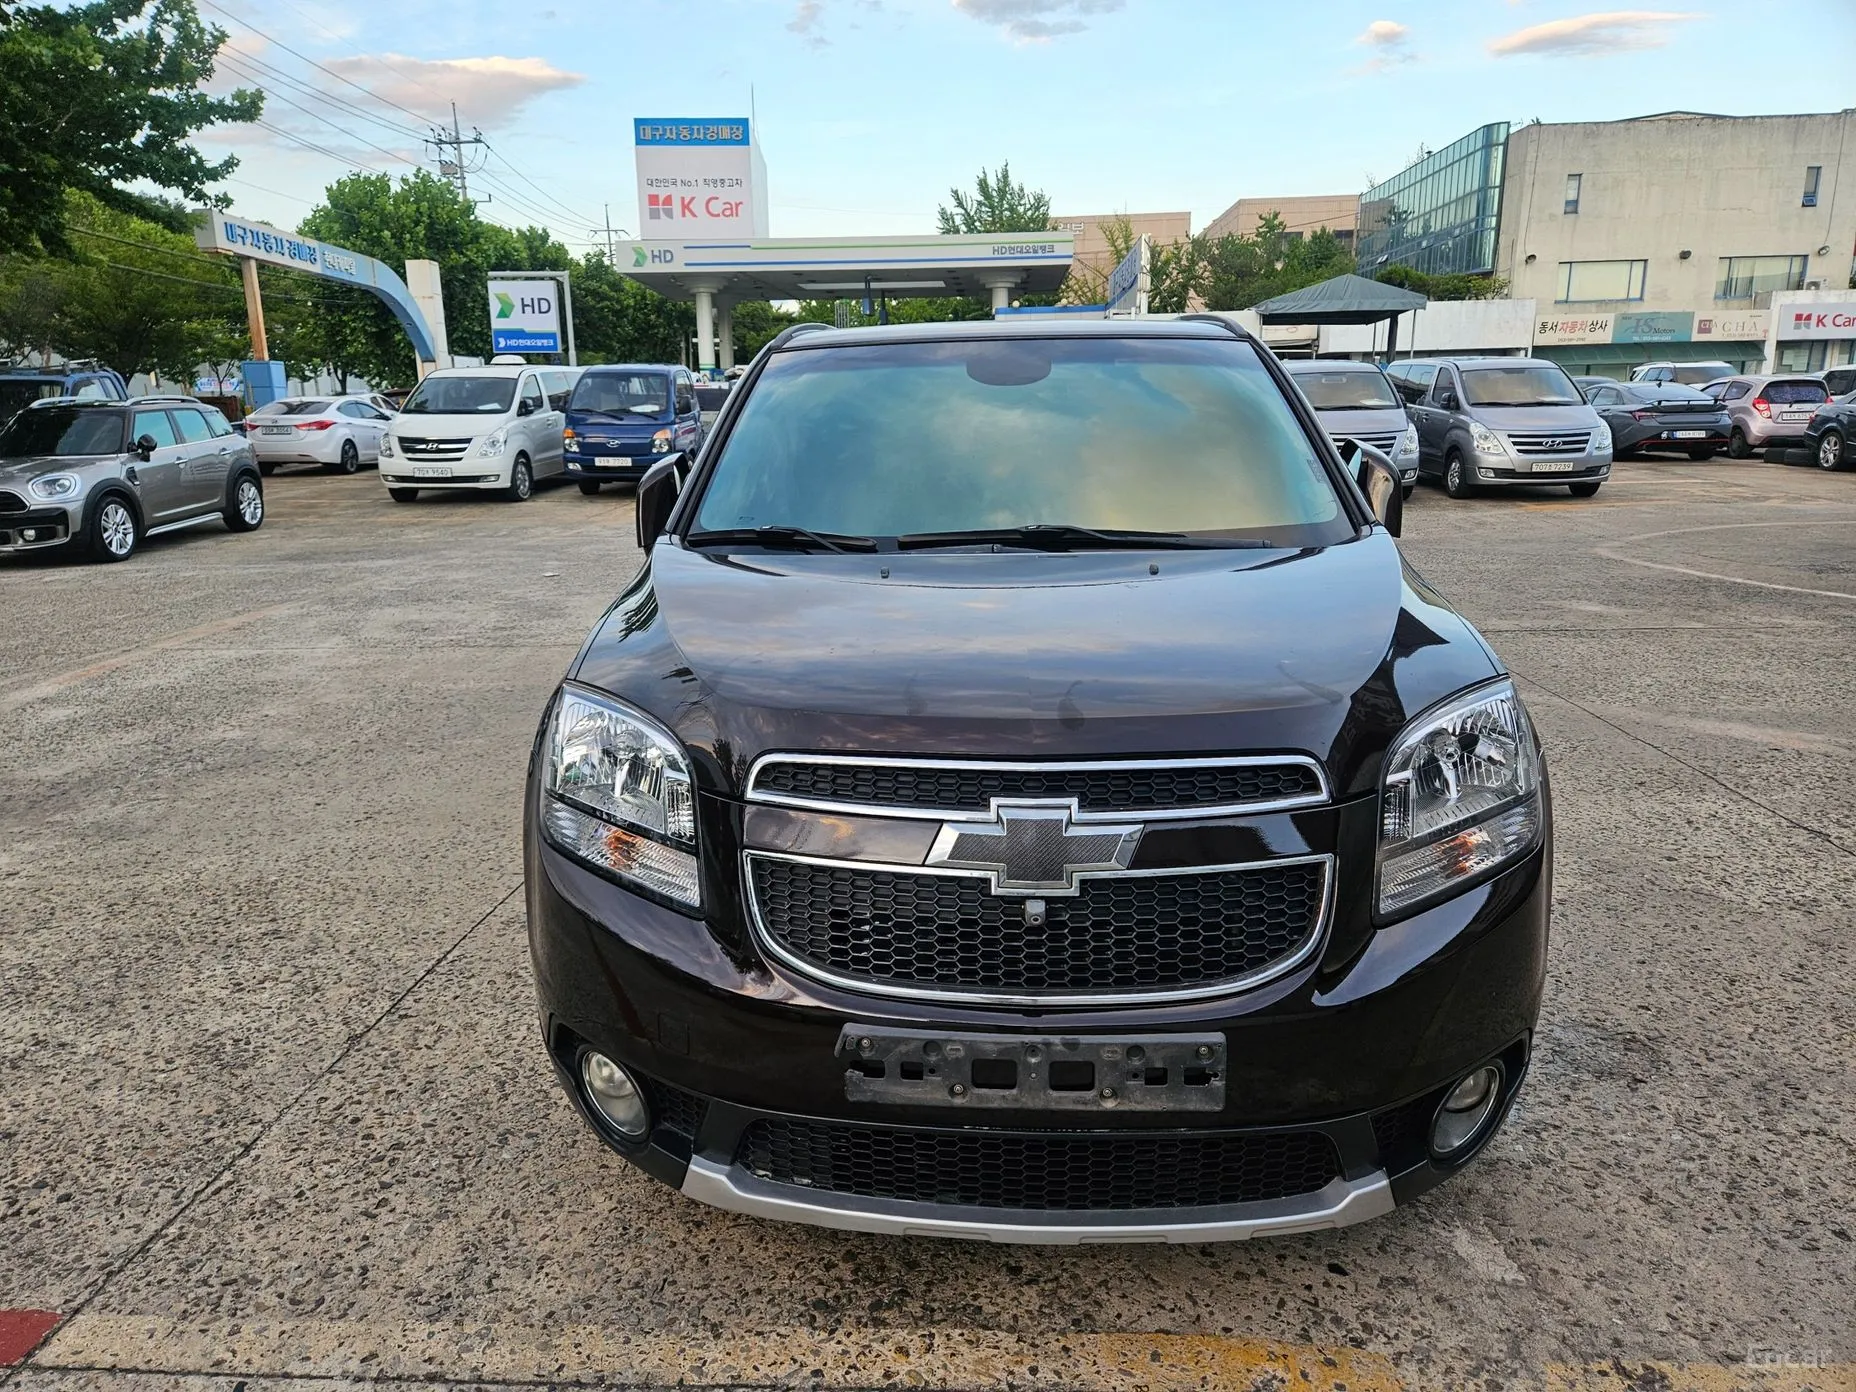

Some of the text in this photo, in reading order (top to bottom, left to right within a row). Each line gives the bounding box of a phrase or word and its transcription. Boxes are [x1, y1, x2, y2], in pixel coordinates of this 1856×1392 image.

[646, 178, 678, 188] 대한민국
[680, 179, 699, 188] No.1
[680, 196, 744, 218] K Car
[651, 250, 674, 264] HD
[520, 297, 552, 315] HD
[1815, 314, 1828, 328] K
